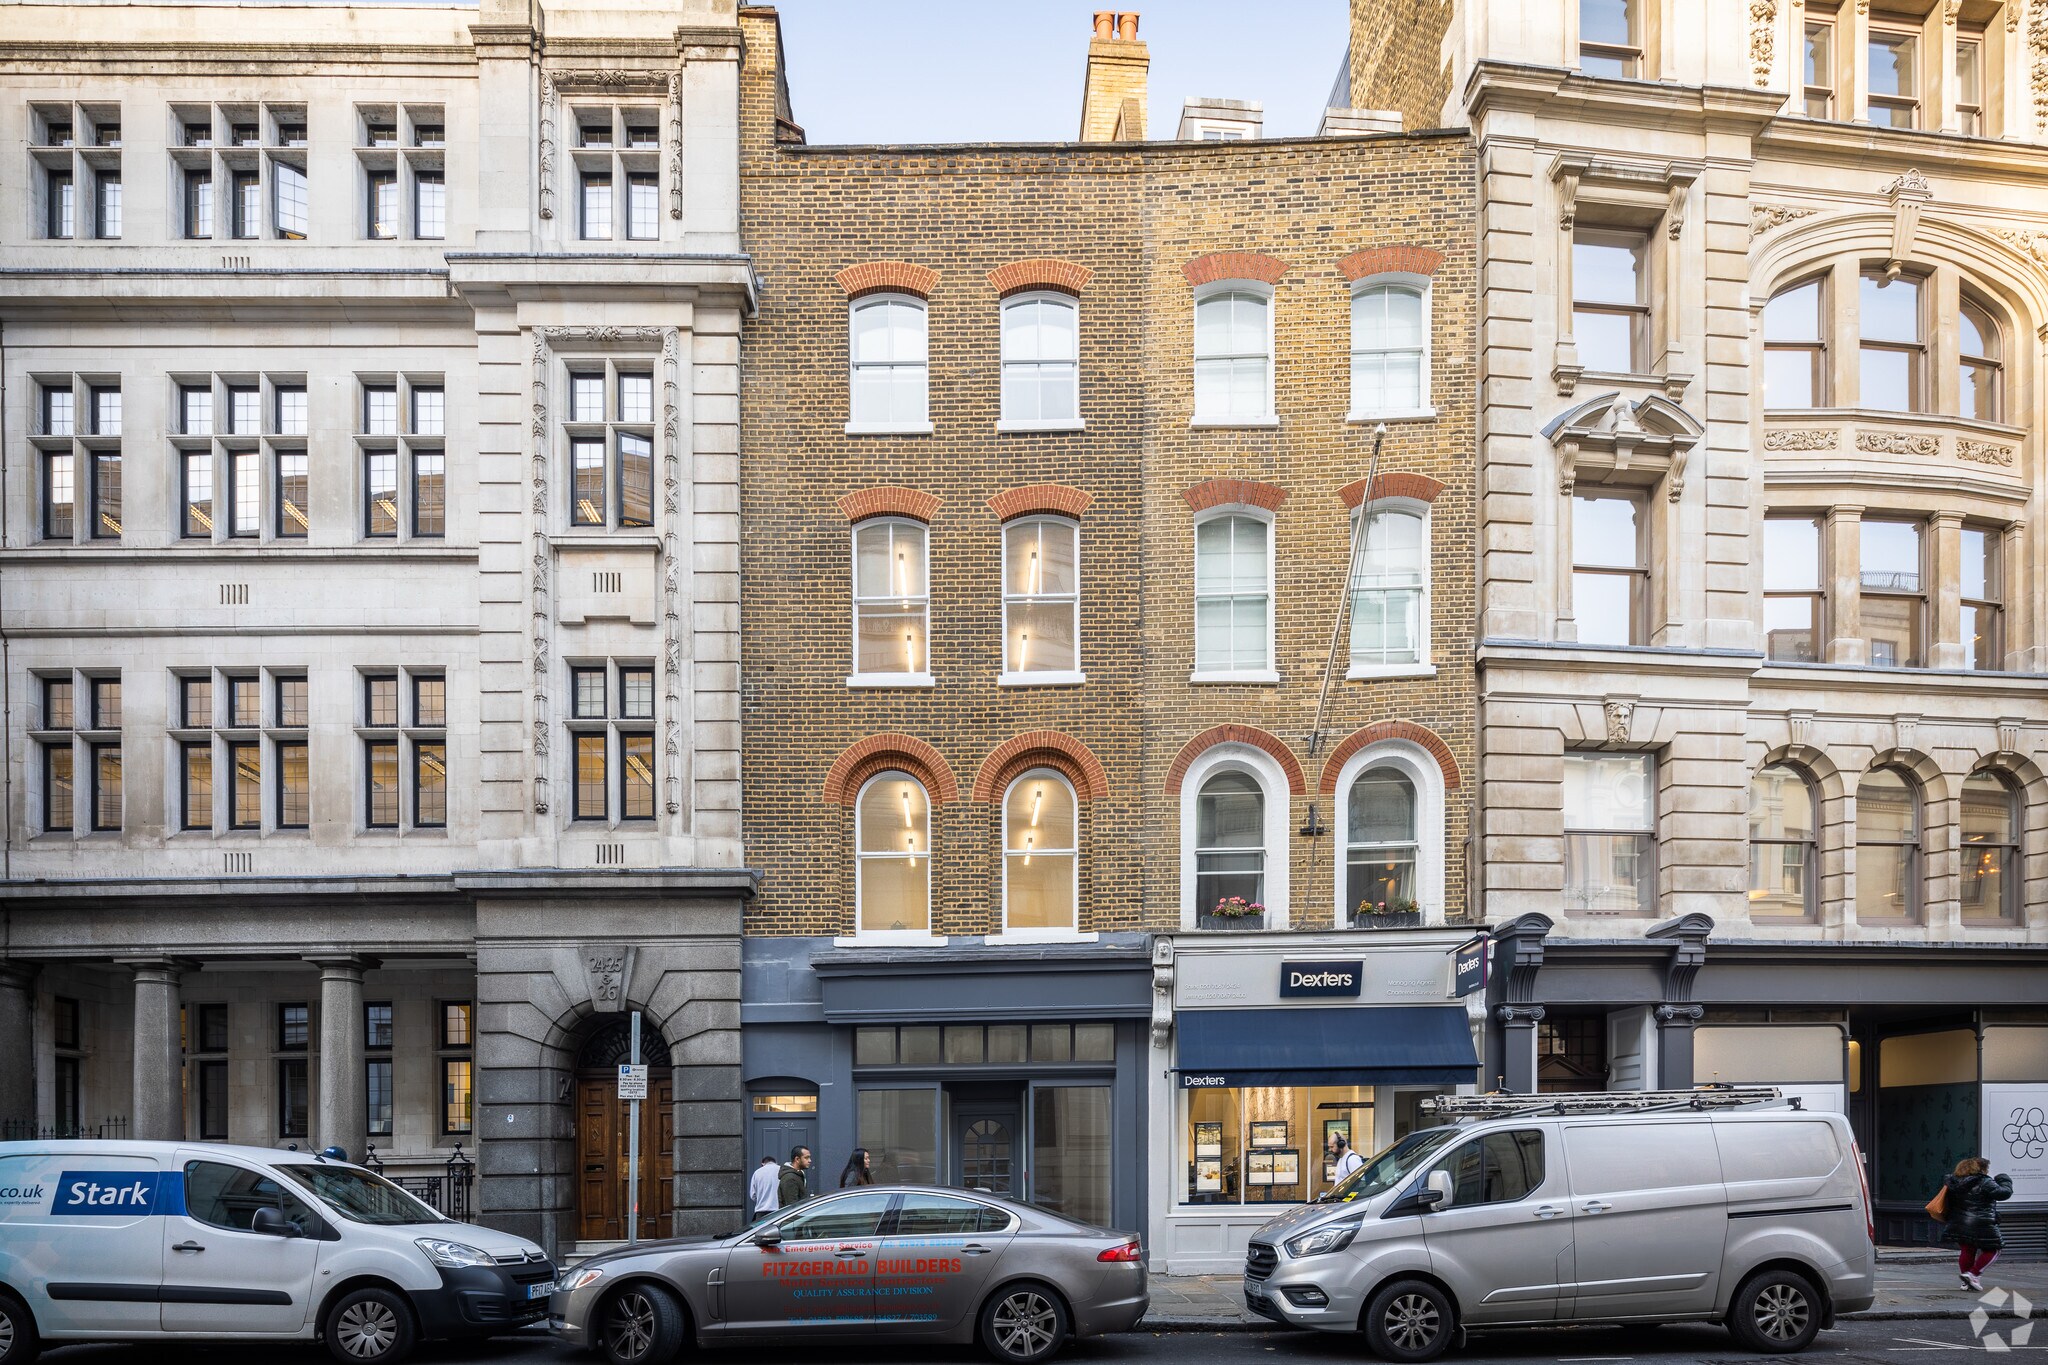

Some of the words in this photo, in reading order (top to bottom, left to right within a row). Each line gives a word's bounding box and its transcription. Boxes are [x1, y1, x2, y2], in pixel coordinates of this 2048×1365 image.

[1457, 956, 1480, 976] Dexters
[1290, 971, 1353, 988] Dexters
[598, 985, 618, 1001] 26
[1184, 1075, 1226, 1086] Dexters
[67, 1181, 150, 1205] Stark
[785, 1244, 835, 1253] Emergency
[839, 1242, 873, 1251] Service
[762, 1260, 869, 1277] FITZGERALD
[877, 1257, 962, 1275] BUILDERS
[793, 1289, 834, 1300] QUALITY
[836, 1288, 891, 1297] ASSURANCE
[893, 1286, 933, 1295] DIVISION
